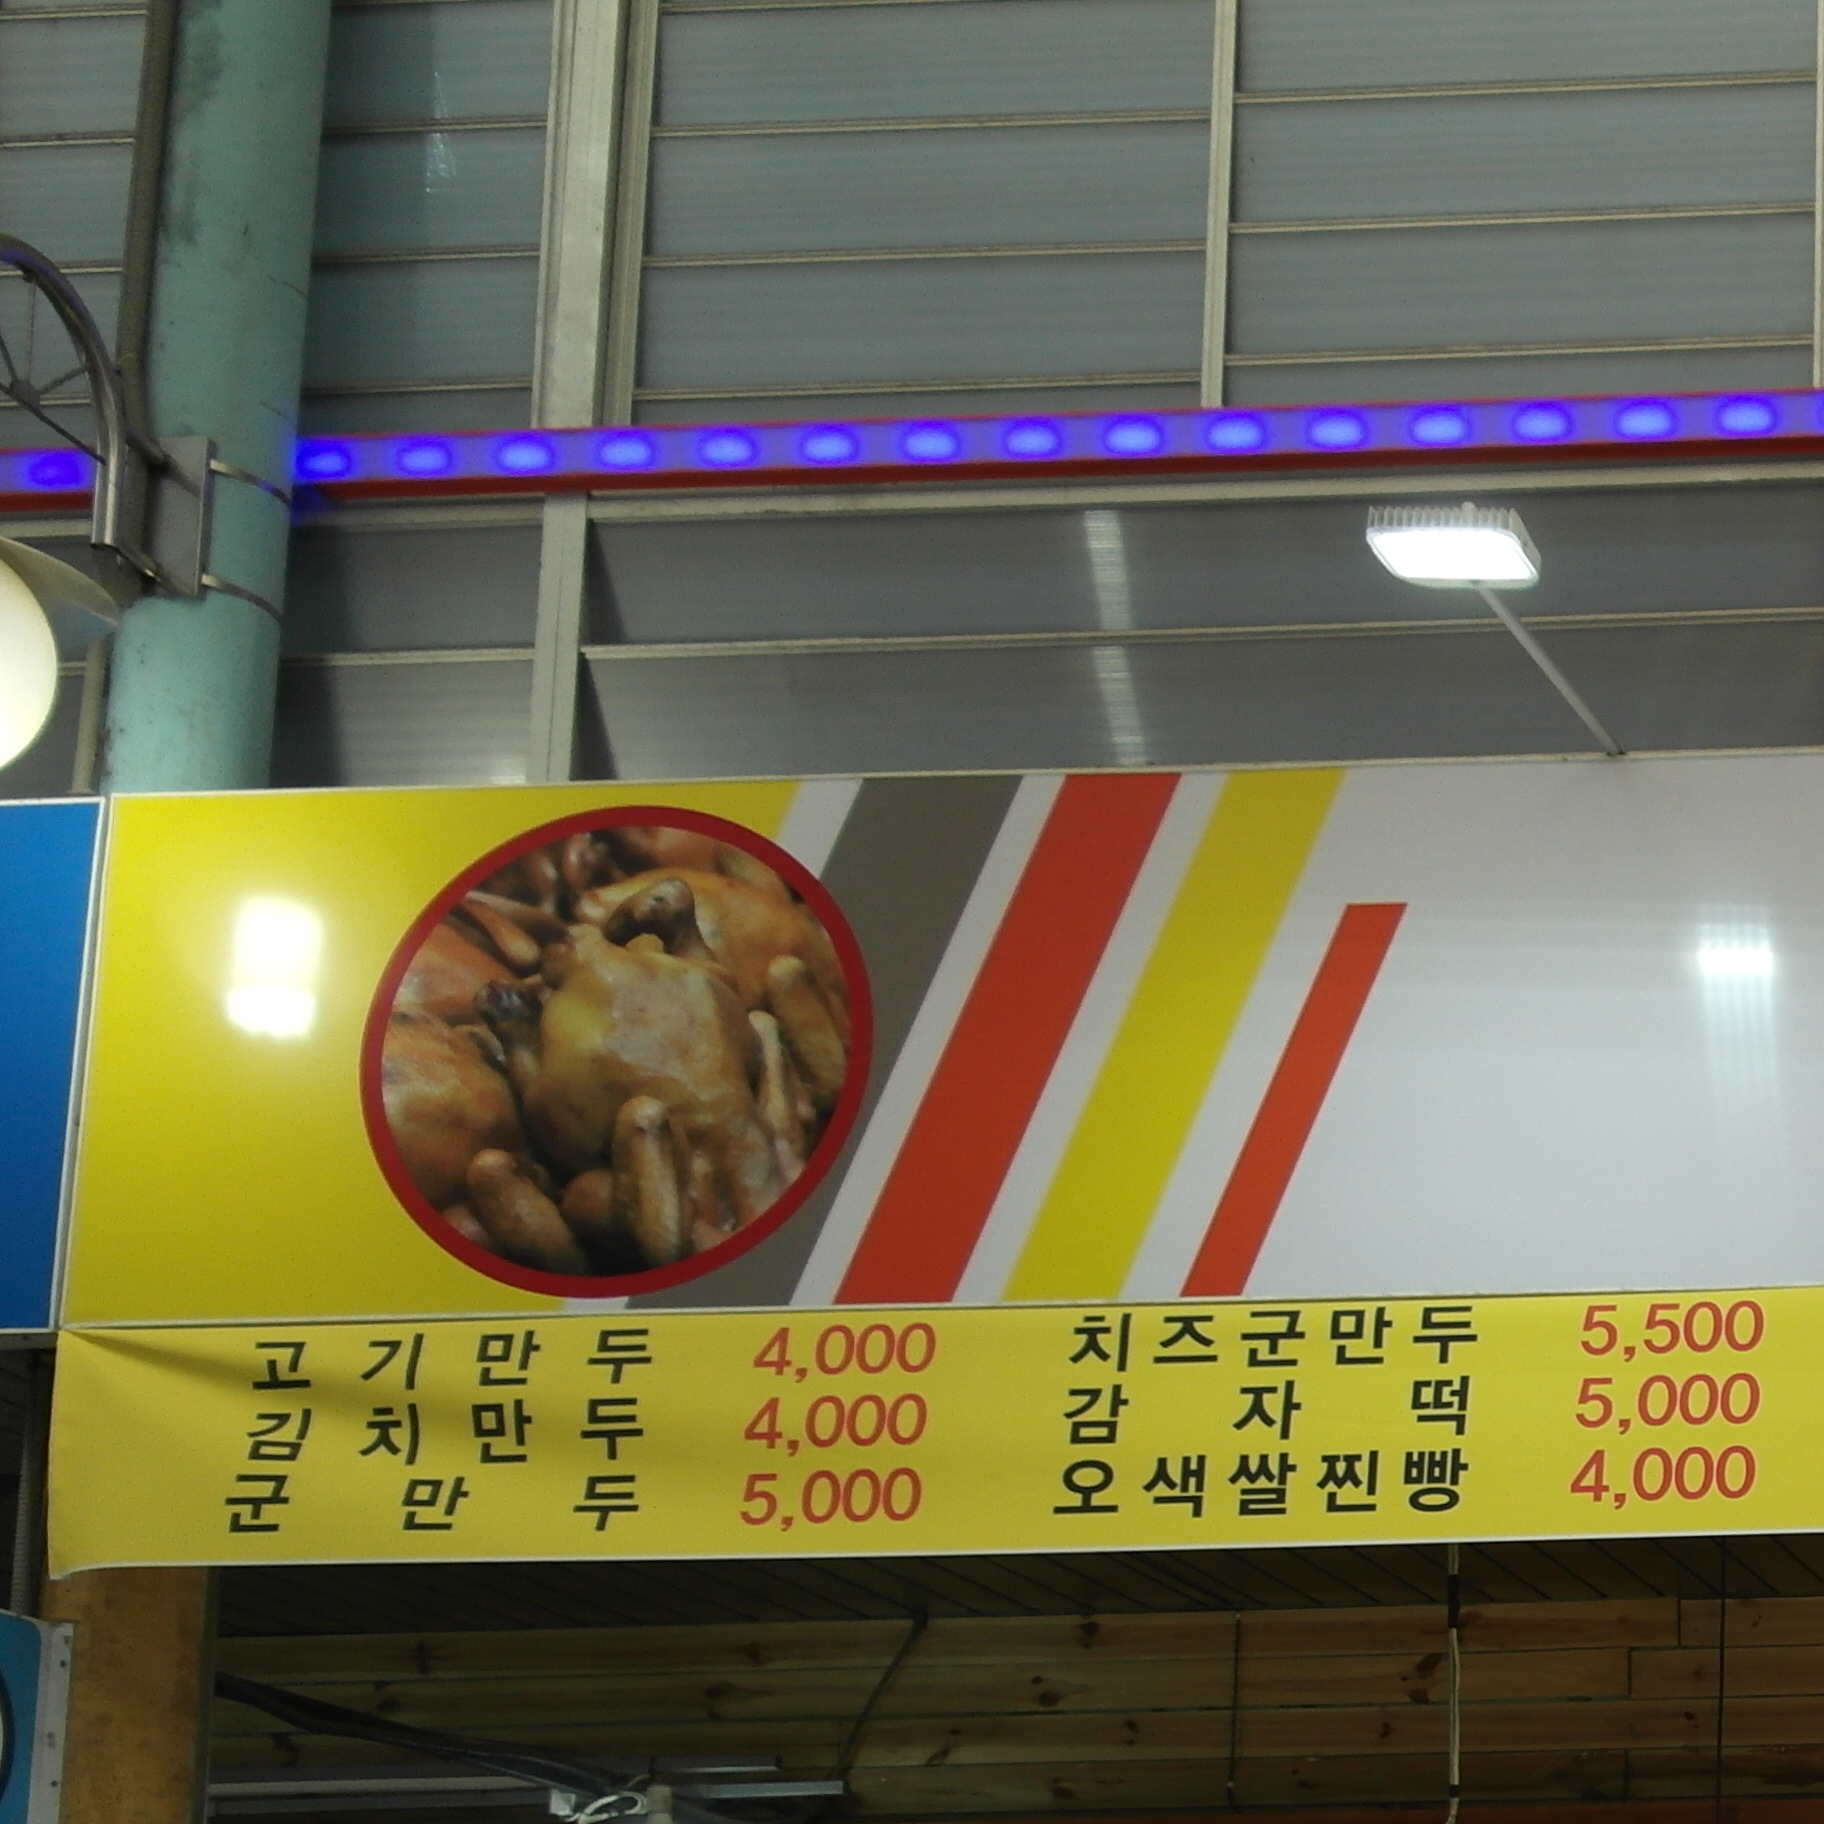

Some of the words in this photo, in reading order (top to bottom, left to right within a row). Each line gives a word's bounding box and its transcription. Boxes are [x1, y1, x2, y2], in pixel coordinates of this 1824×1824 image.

[253, 1330, 652, 1391] 고기만두
[752, 1323, 935, 1383] 4,000
[1071, 1308, 1478, 1372] 치즈군만두
[1579, 1299, 1764, 1362] 5,500
[249, 1399, 644, 1465] 김치만두
[743, 1393, 927, 1455] 4,000
[1574, 1372, 1760, 1436] 5,000
[739, 1467, 922, 1531] 5,000
[1055, 1450, 1469, 1518] 오색쌀찐빵
[1569, 1445, 1757, 1510] 4,000
